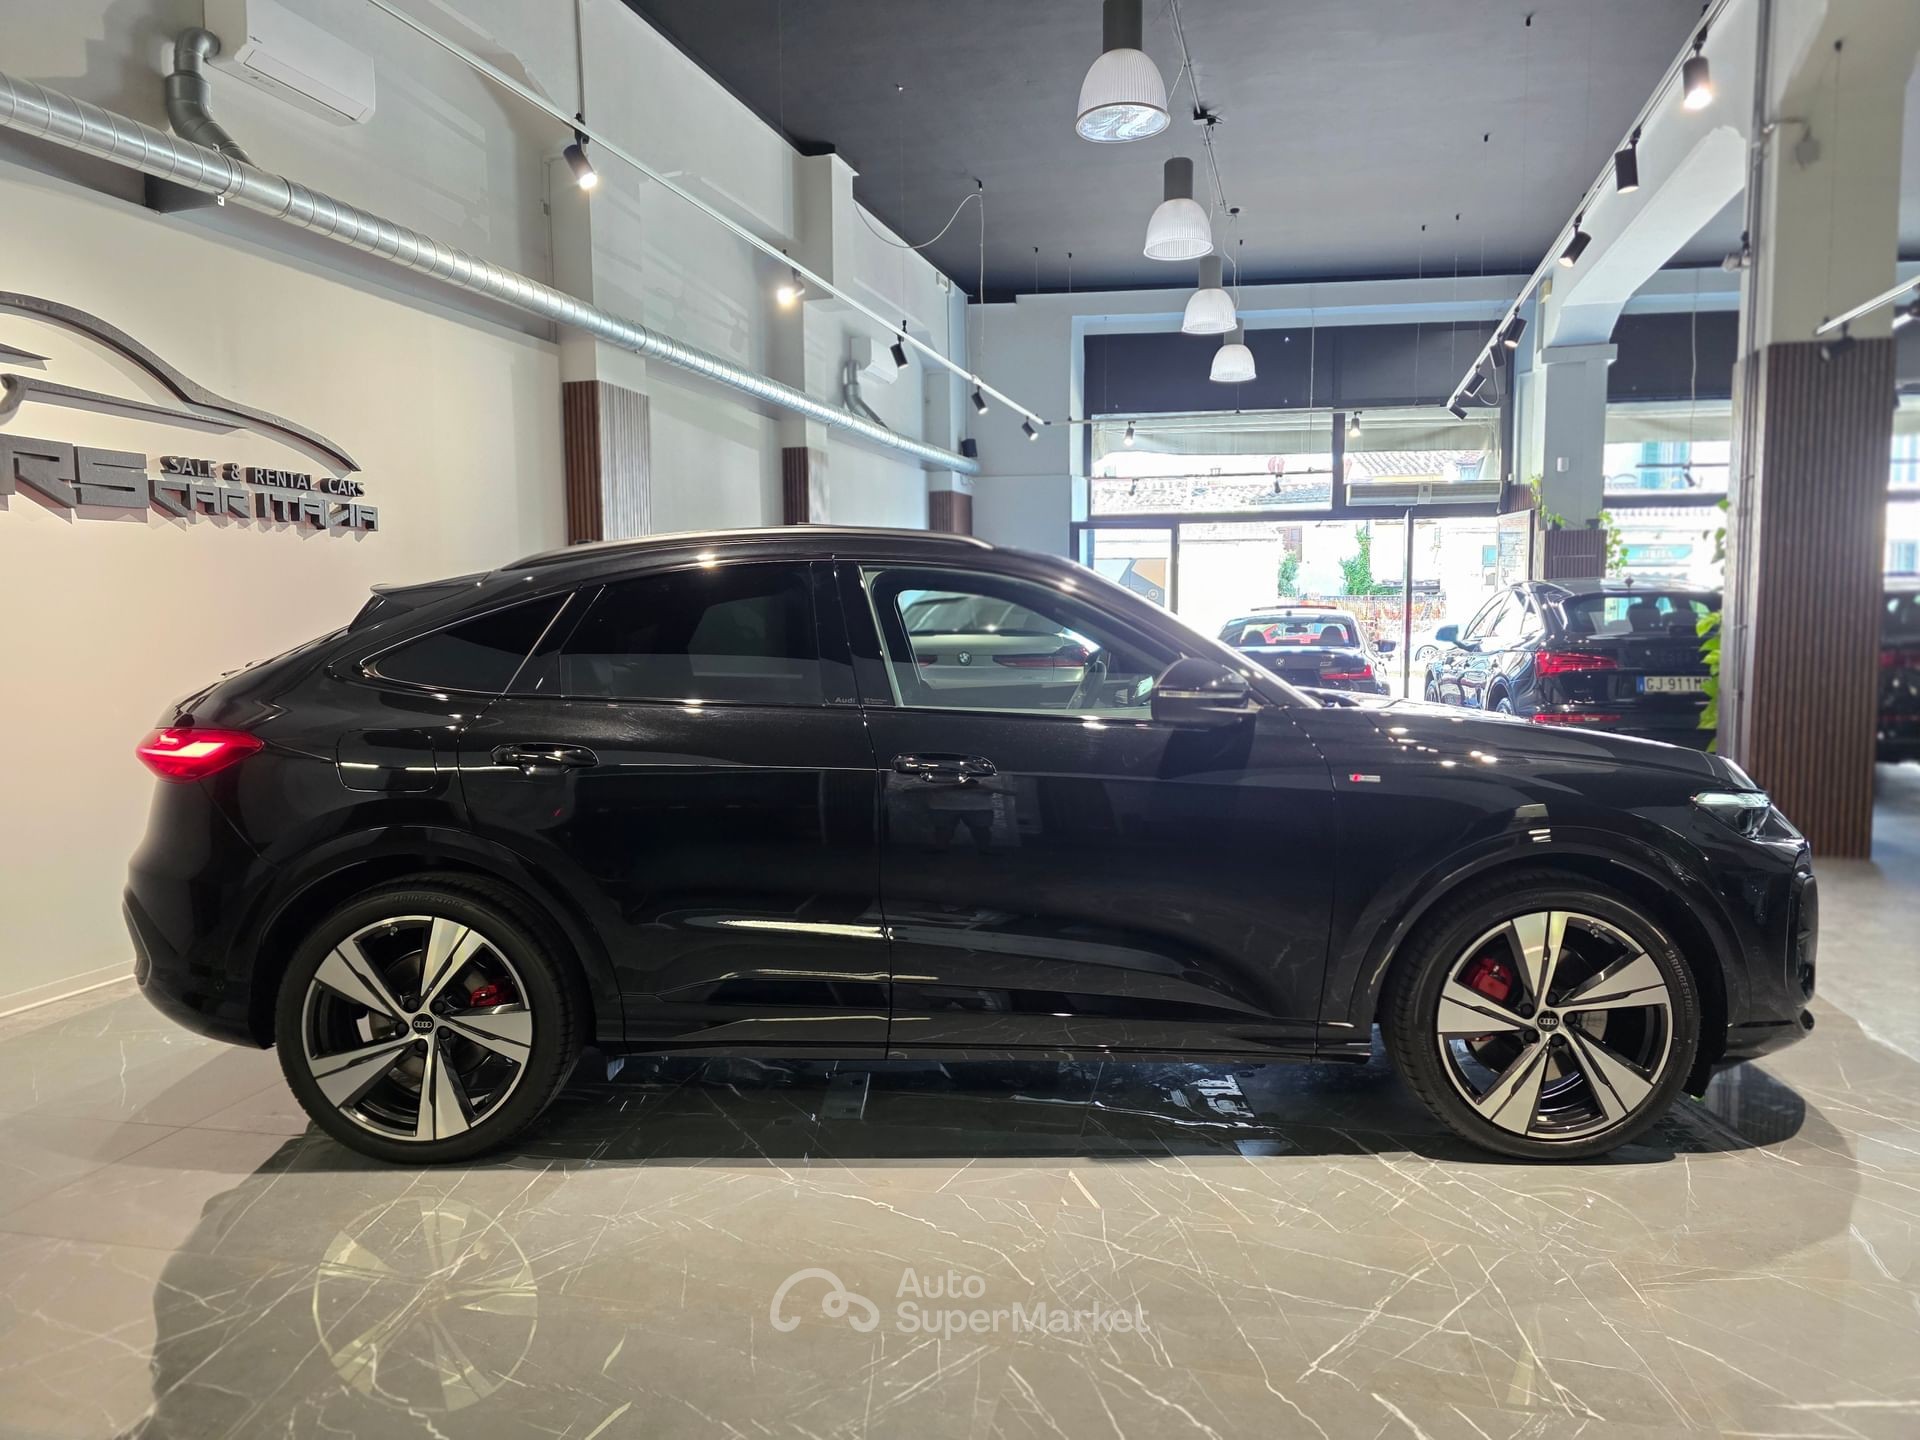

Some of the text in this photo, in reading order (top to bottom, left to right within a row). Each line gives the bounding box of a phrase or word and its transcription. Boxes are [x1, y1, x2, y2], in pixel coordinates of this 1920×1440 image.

[0, 433, 378, 531] RS CAR ITALIA
[162, 456, 365, 497] SALE & RENTAL CARS
